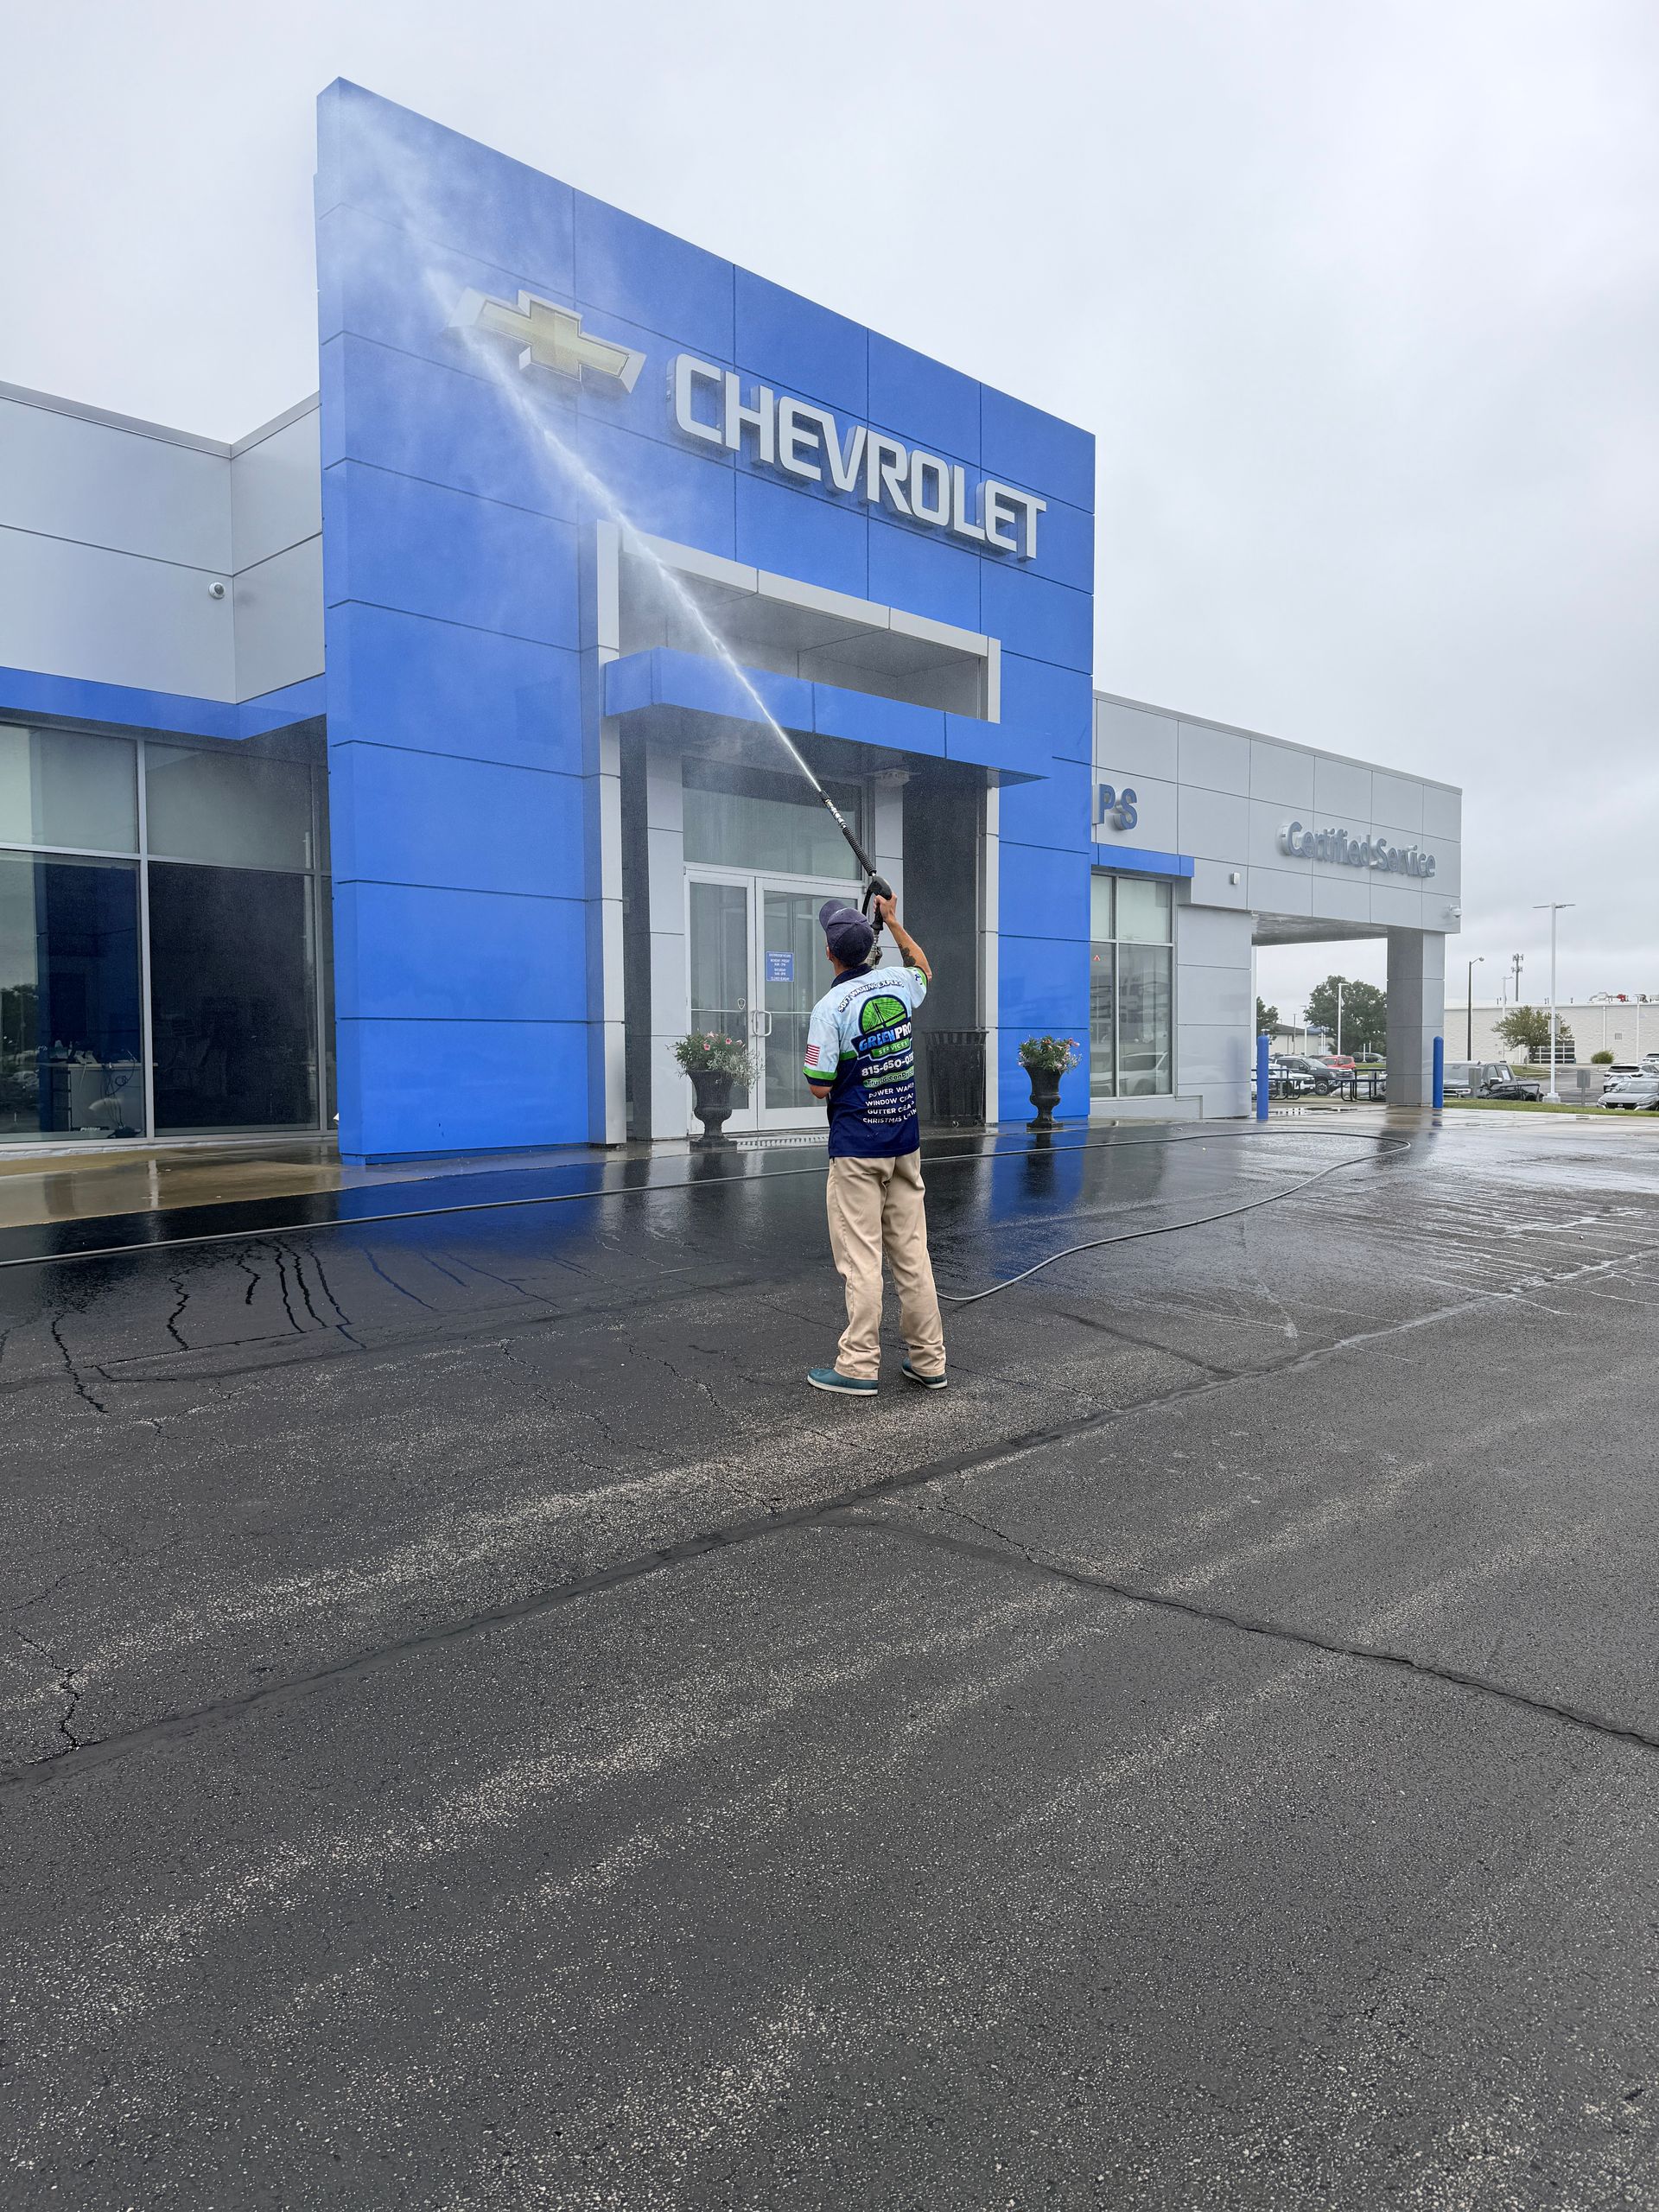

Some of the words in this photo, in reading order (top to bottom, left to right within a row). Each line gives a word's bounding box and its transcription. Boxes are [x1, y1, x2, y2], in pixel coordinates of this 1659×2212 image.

[667, 353, 1046, 561] CHEVROLET
[1287, 821, 1370, 868] Certified
[1372, 837, 1436, 878] Service
[837, 995, 853, 1013] SOFT
[859, 1021, 912, 1052] GREENPRO
[878, 1040, 908, 1055] SERVICES
[865, 1097, 898, 1107] WINDOW
[868, 1088, 893, 1099] POWER
